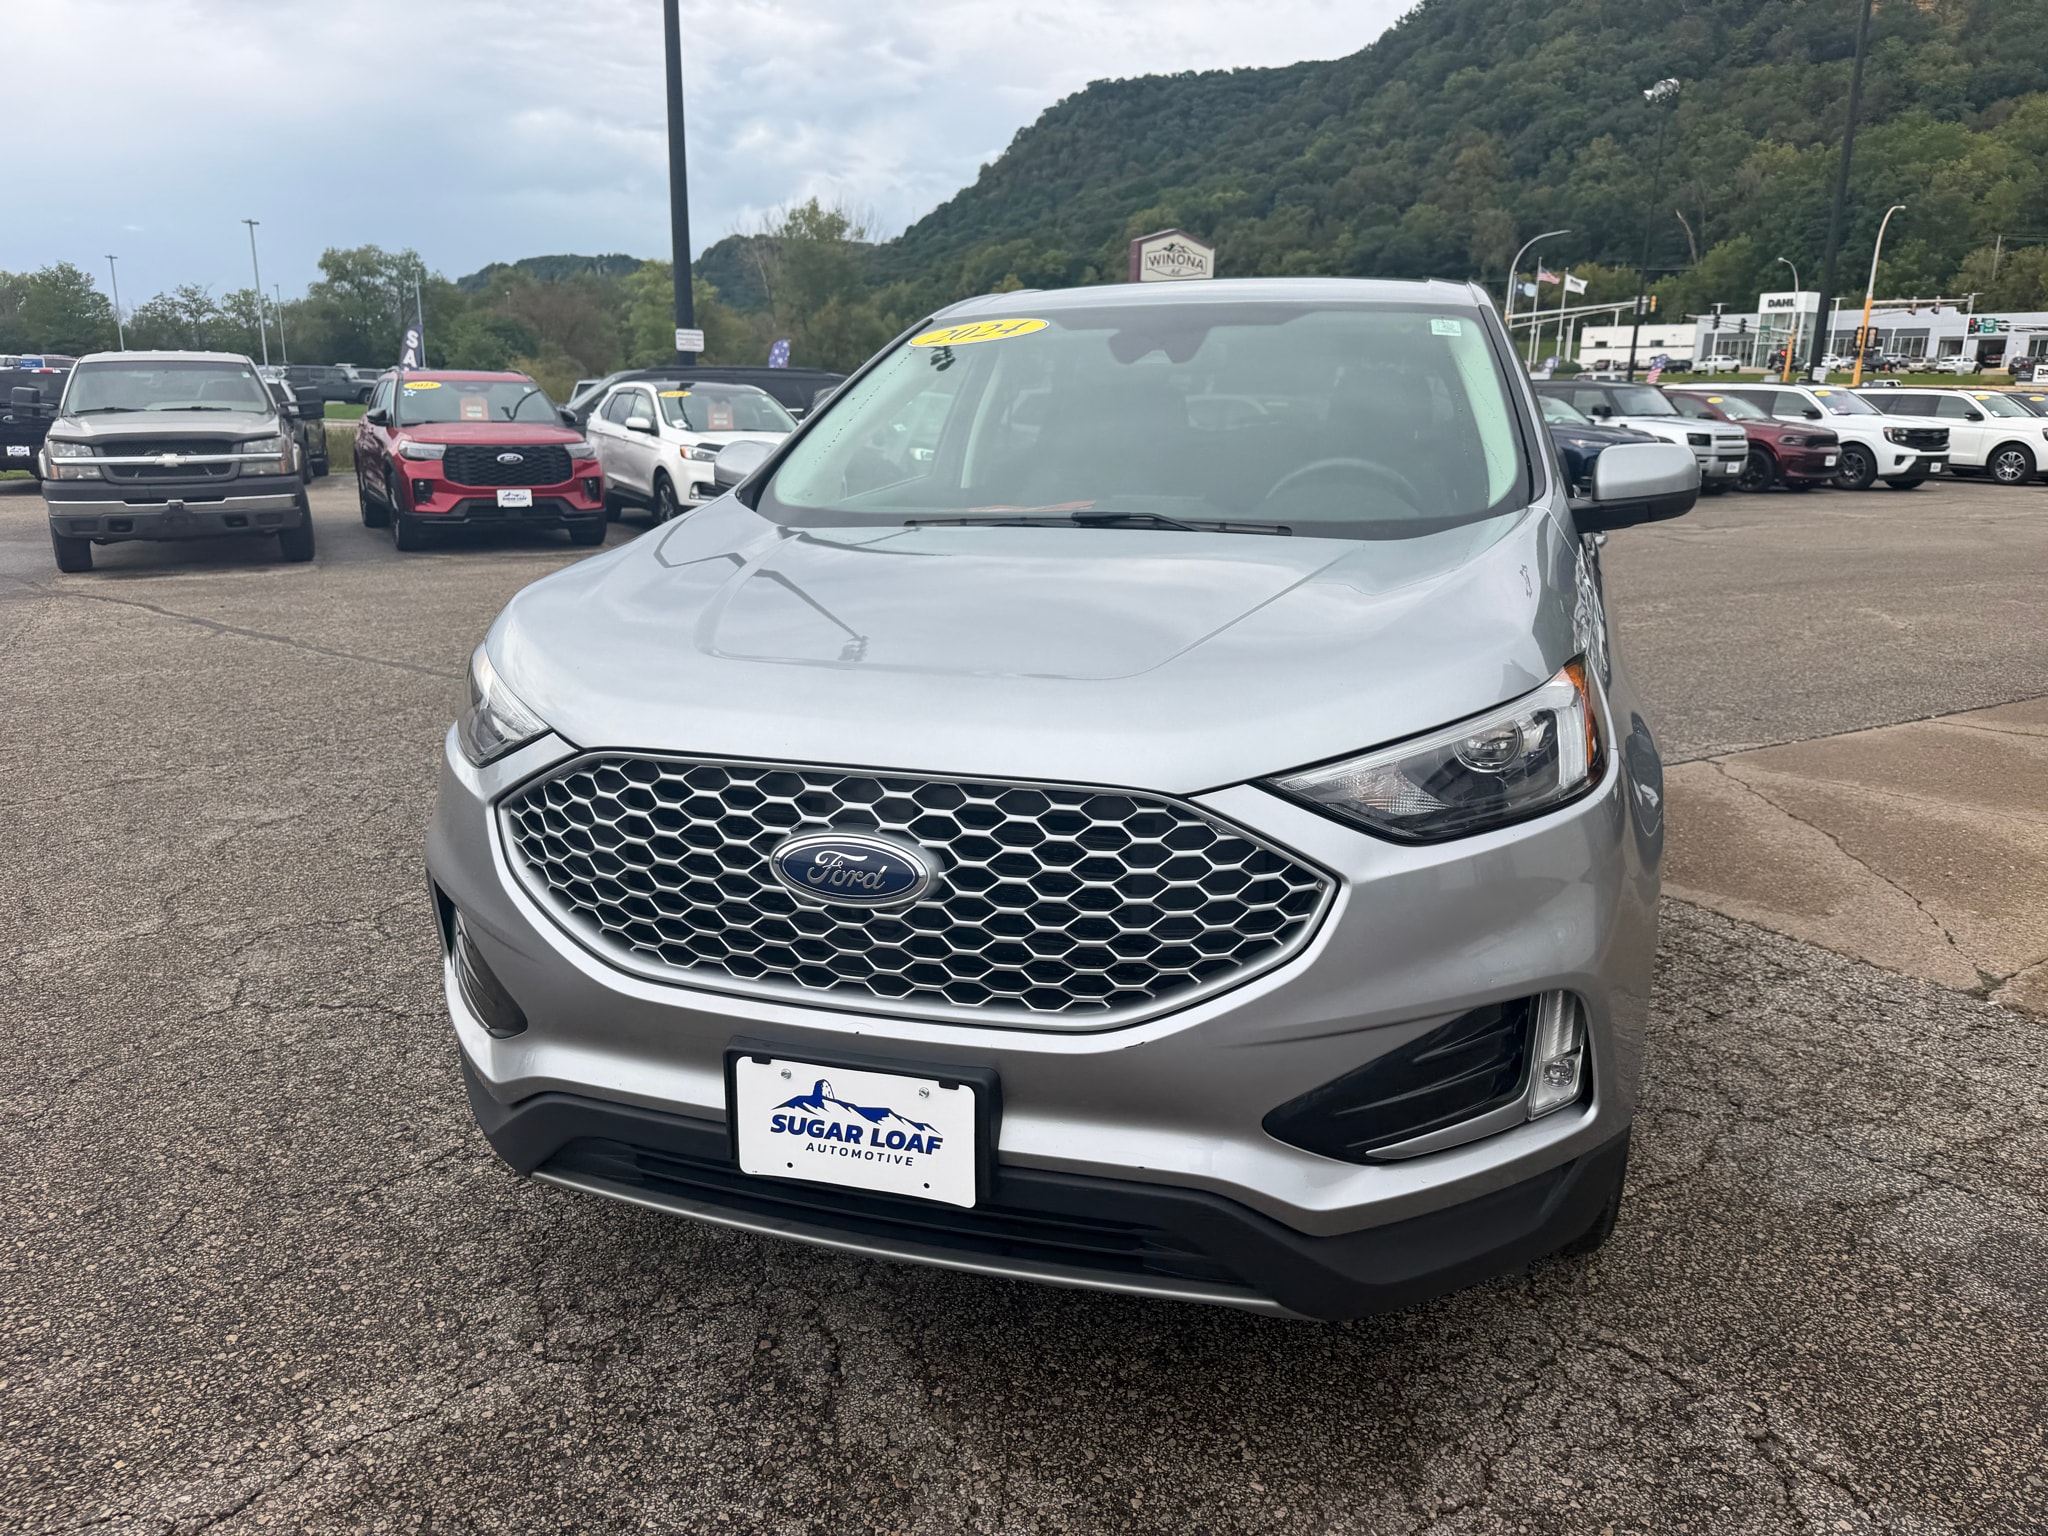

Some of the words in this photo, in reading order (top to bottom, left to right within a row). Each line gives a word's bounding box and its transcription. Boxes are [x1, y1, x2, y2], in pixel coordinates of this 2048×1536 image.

[1148, 253, 1204, 271] WINONA
[1768, 298, 1795, 308] DAHL
[922, 320, 1032, 345] 2024
[402, 330, 419, 371] SA
[806, 850, 888, 890] Ford
[770, 1113, 864, 1145] SUGAR
[870, 1127, 943, 1155] LOAF
[805, 1142, 915, 1167] AUTOMOTIVE
